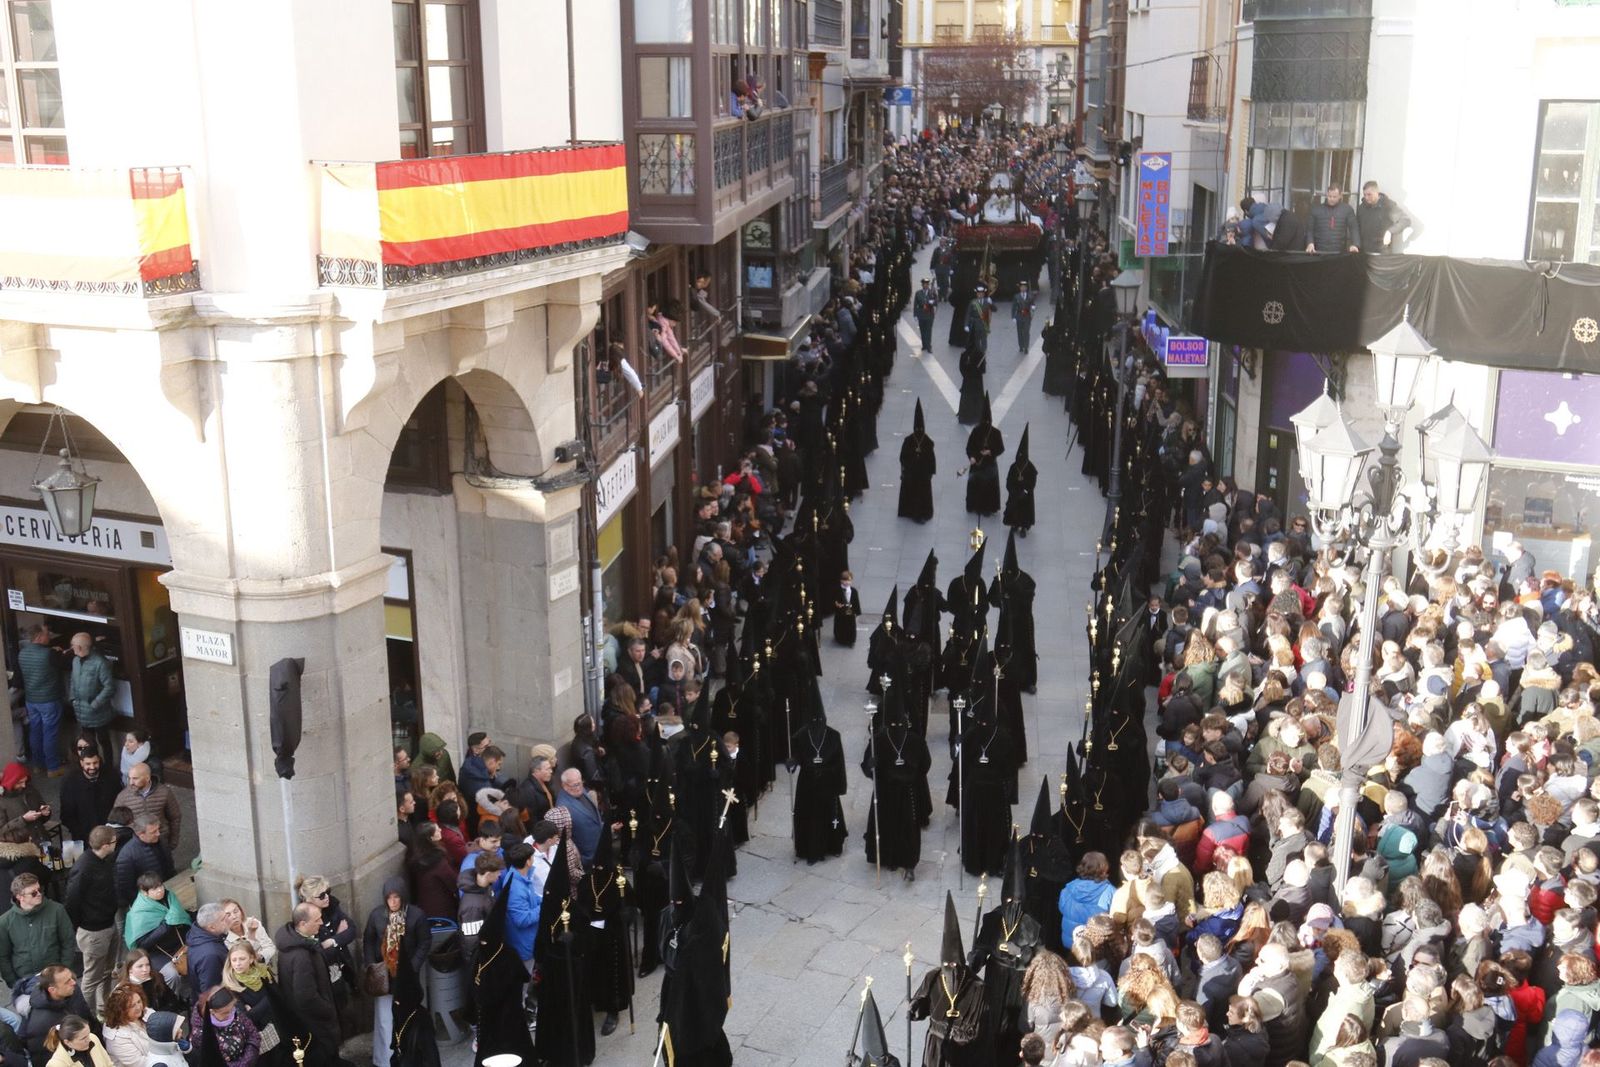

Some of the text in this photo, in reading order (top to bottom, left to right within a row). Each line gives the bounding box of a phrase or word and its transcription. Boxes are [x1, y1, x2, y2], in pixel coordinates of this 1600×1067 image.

[1140, 181, 1153, 254] MALETAS
[1154, 181, 1169, 255] BOLSOS
[1170, 341, 1204, 351] BOLSOS
[1168, 353, 1206, 363] MALETAS
[196, 634, 226, 647] PLAZA
[196, 646, 228, 659] MAYOR
